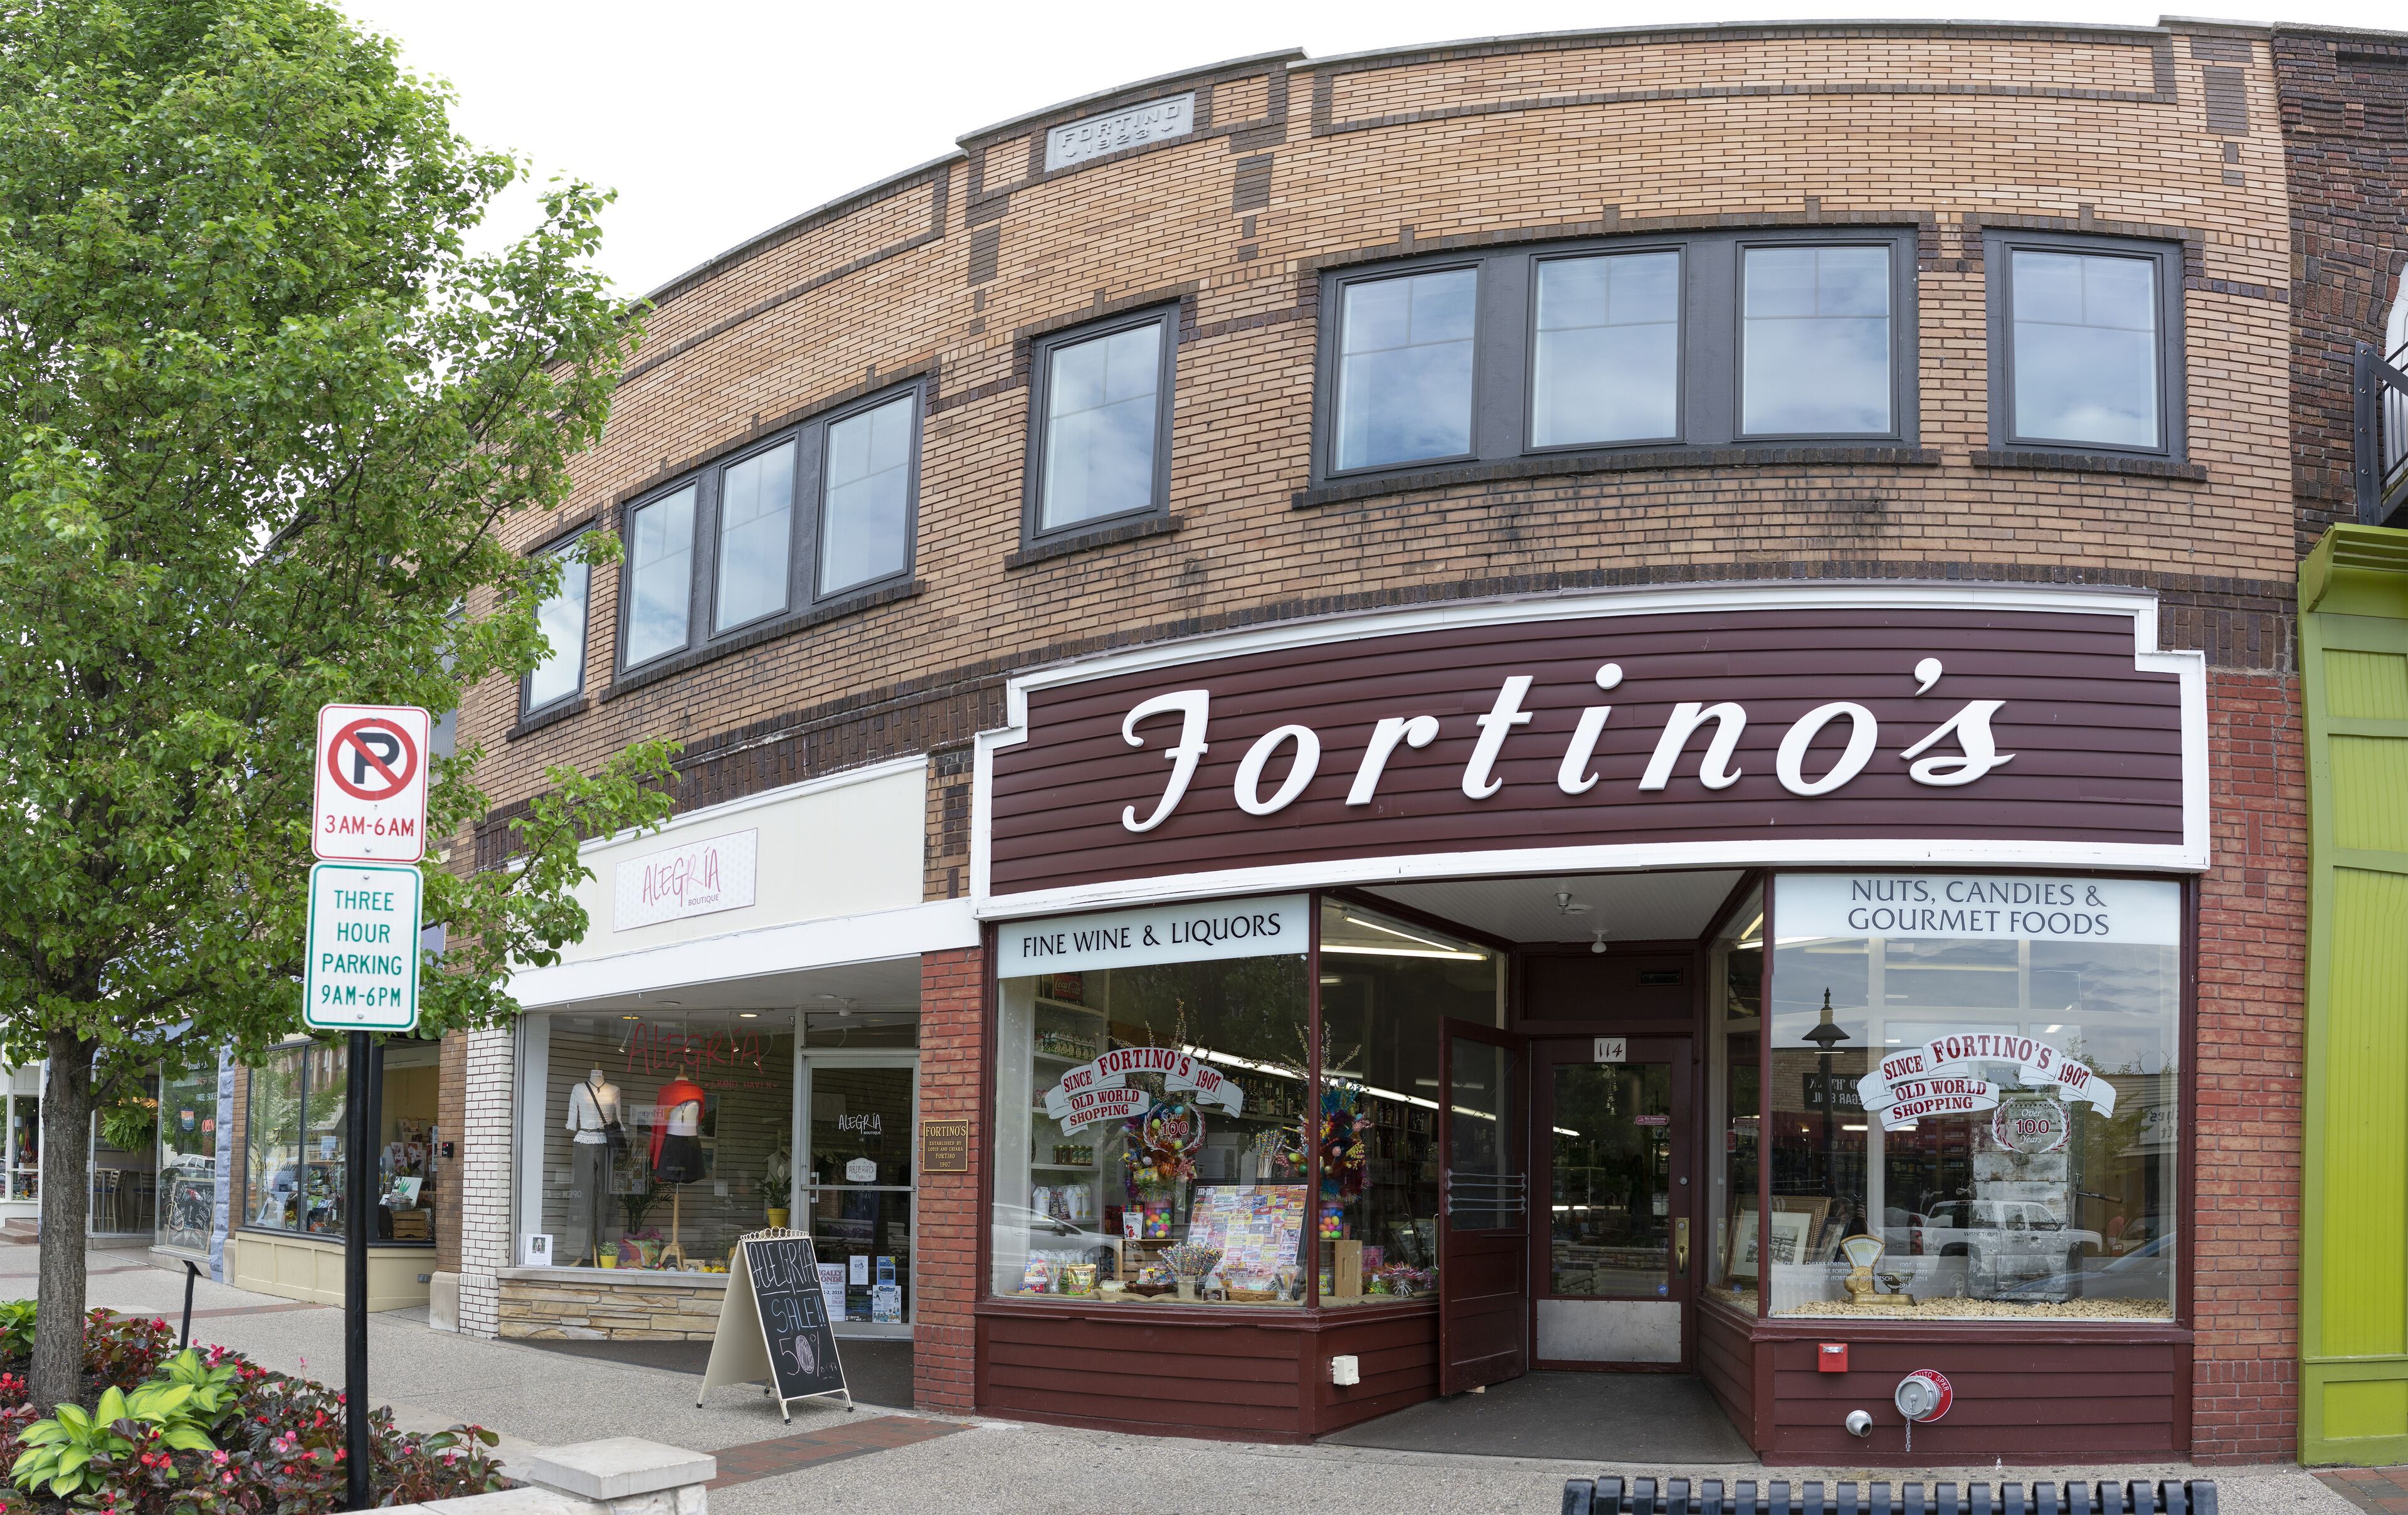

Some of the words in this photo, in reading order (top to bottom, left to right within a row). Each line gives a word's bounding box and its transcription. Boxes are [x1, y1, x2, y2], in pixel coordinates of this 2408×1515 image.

[1062, 105, 1180, 147] FORTINO
[1087, 129, 1149, 153] 1923
[1121, 658, 2016, 833] Fortino's
[334, 890, 394, 912] THREE
[688, 894, 719, 906] BOUTIQUE
[1851, 879, 1936, 905] NUTS,
[1946, 880, 2074, 907] CANDIES
[2086, 885, 2108, 907] &
[1847, 907, 2001, 932] GOURMET
[2009, 911, 2110, 936] FOODS
[337, 922, 390, 944] HOUR
[1023, 934, 1067, 958] FINE
[1073, 927, 1131, 953] WINE
[1143, 925, 1161, 946] &
[1171, 912, 1281, 946] LIQUORS
[322, 953, 402, 976] PARKING
[1599, 1043, 1623, 1058] 114
[1930, 1035, 2052, 1070] FORTINO'S
[1097, 1048, 1191, 1077] FORTINO'S
[1883, 1055, 1924, 1080] SINCE
[2057, 1062, 2090, 1090] 1907
[1063, 1070, 1092, 1093] SINCE
[1195, 1069, 1222, 1093] 1907
[1894, 1083, 1926, 1102] OLD
[1930, 1079, 1987, 1095] WORLD
[1071, 1094, 1094, 1111] OLD
[1097, 1089, 1139, 1104] WORLD
[1893, 1096, 1973, 1121] SHOPPING
[1069, 1104, 1129, 1126] SHOPPING
[1166, 1112, 1183, 1121] Over
[2021, 1109, 2041, 1117] Over
[202, 1119, 214, 1132] OPEN
[926, 1125, 966, 1137] FORTINO'S
[1161, 1121, 1189, 1136] 100
[2015, 1118, 2050, 1135] 100
[2020, 1135, 2042, 1144] Years
[848, 1165, 874, 1174] ABIERTO
[1935, 1375, 1950, 1391] SPKR
